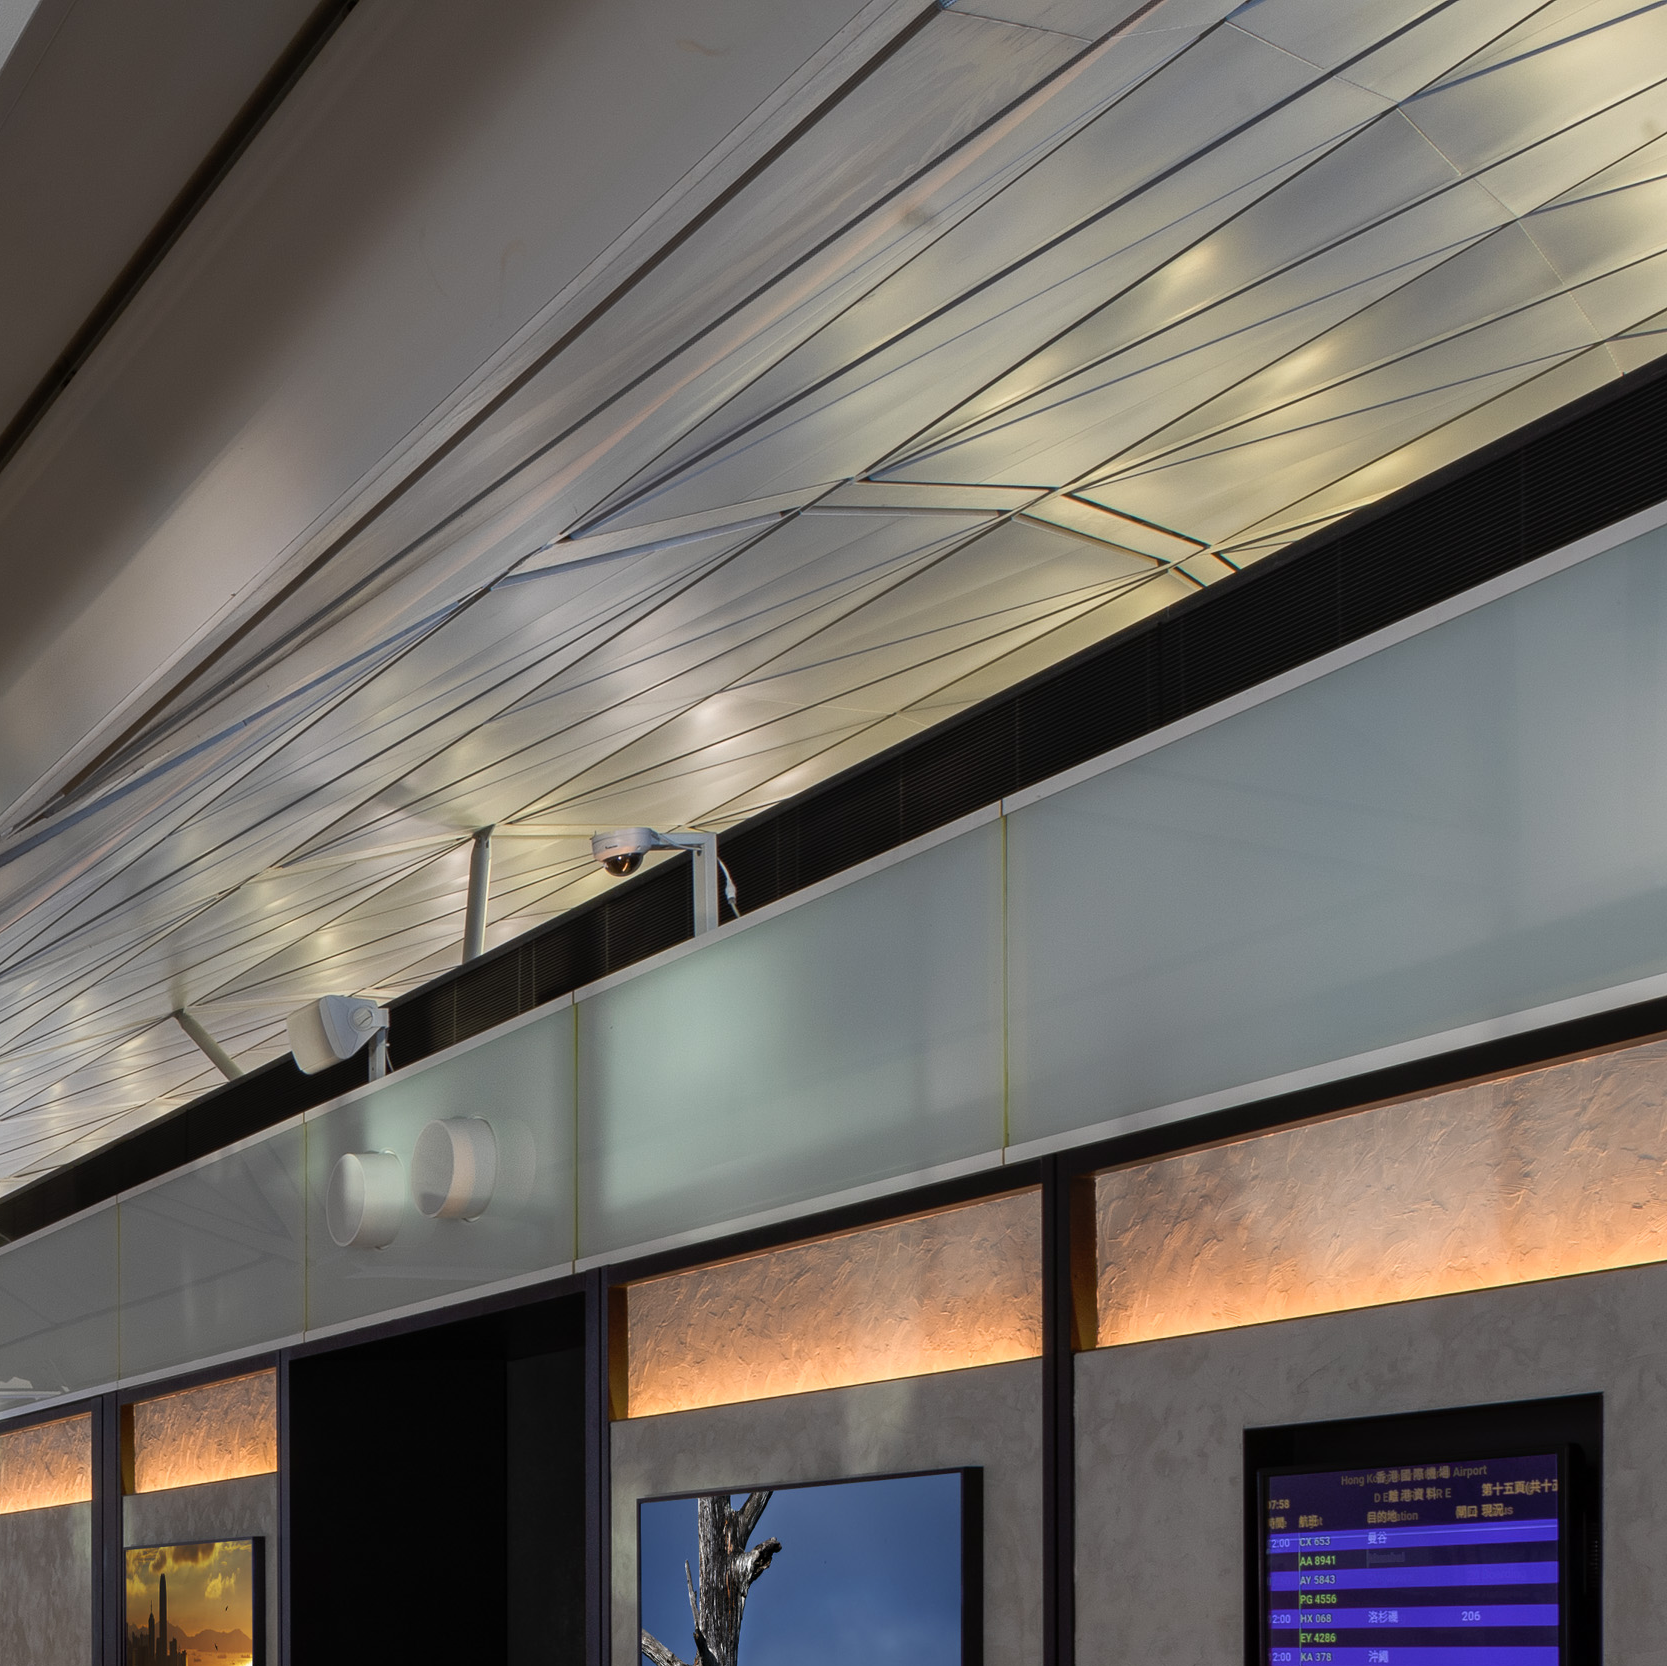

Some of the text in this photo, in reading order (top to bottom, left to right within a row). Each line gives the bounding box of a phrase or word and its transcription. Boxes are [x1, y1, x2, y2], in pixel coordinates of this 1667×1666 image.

[1340, 1475, 1365, 1487] Hong
[1453, 1465, 1487, 1479] Airport
[1269, 1536, 1331, 1548] 2:00 CX 653
[1368, 1531, 1388, 1545] 曼谷
[1299, 1555, 1336, 1567] AA 8941
[1300, 1574, 1336, 1586] AY 5843
[1300, 1594, 1337, 1605] PG 4556
[1269, 1613, 1332, 1624] 2:00 HX 068
[1461, 1610, 1481, 1622] 206
[1300, 1632, 1337, 1643] EY 4286
[1269, 1652, 1332, 1662] 2:00 KA 378
